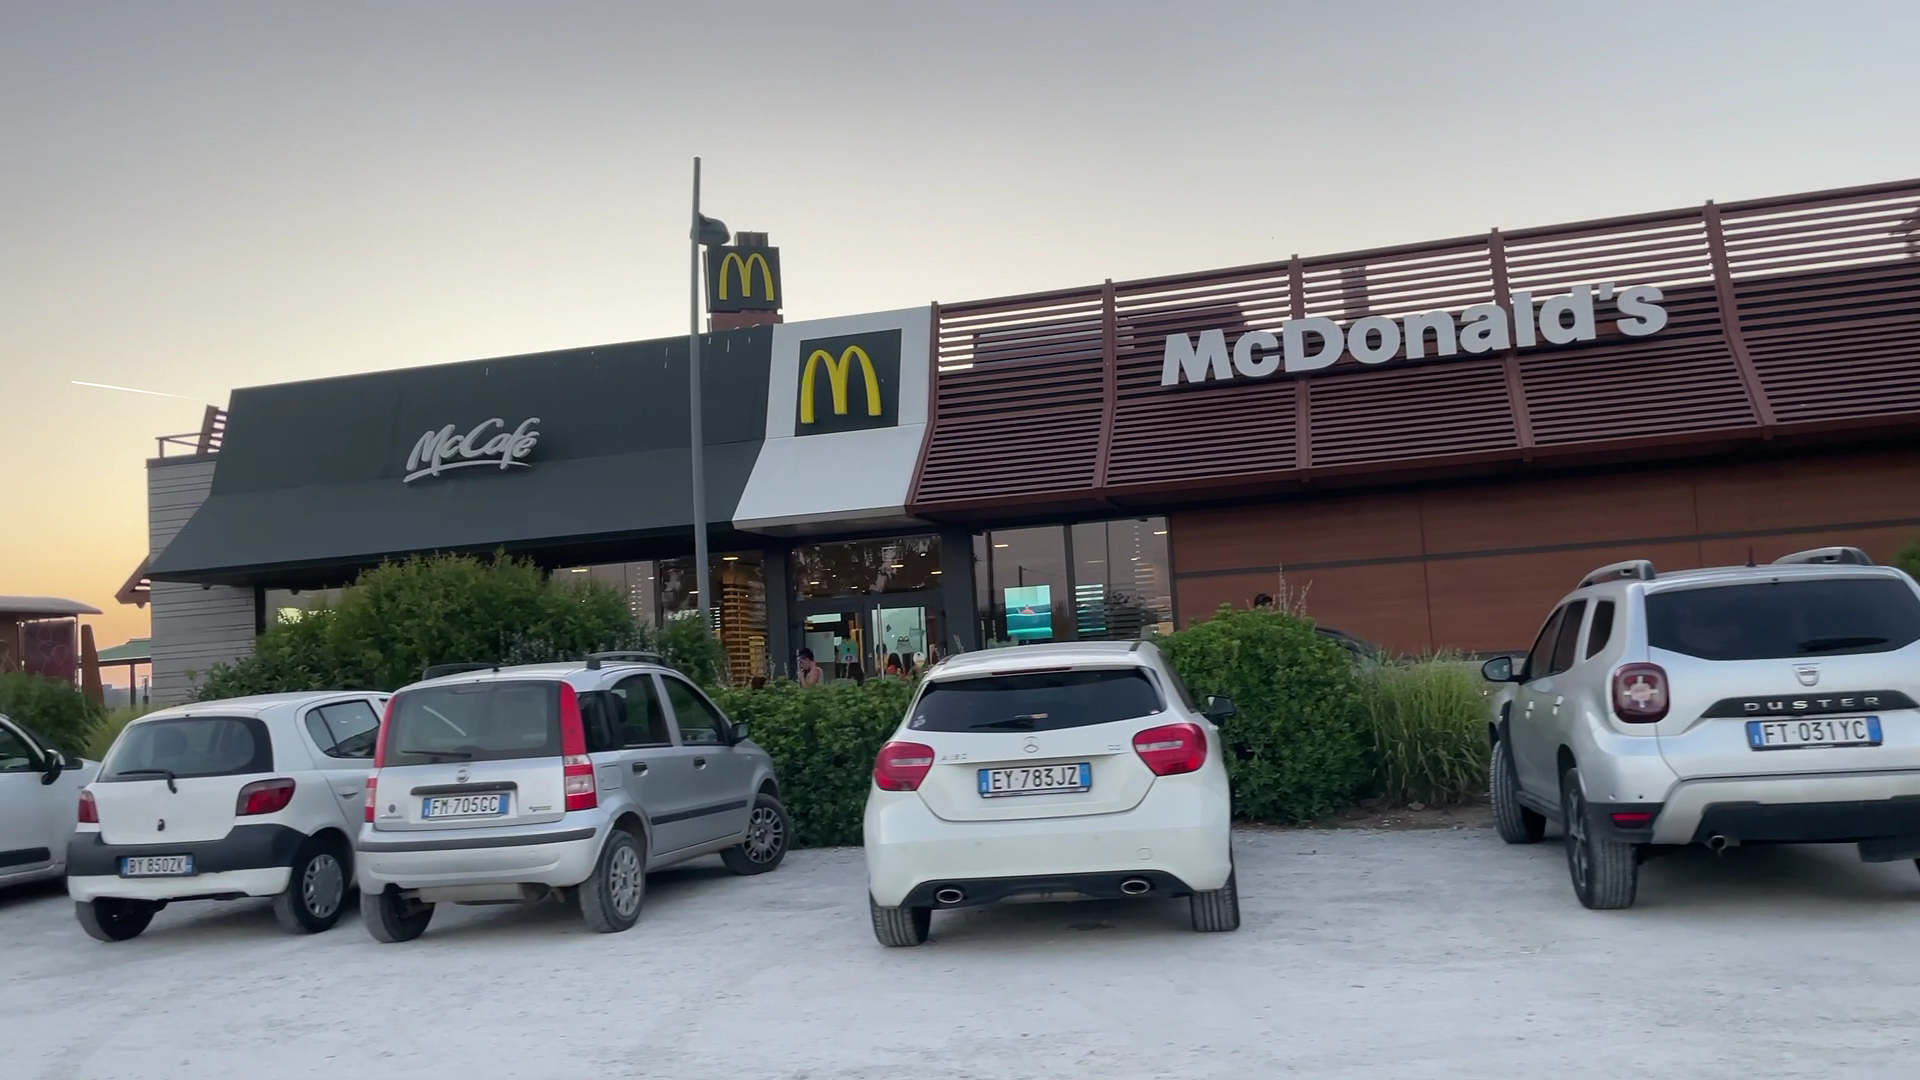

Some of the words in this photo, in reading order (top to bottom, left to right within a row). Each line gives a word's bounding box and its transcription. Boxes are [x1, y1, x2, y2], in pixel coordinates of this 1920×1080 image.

[1161, 281, 1668, 386] McDonald's
[404, 417, 540, 479] McCafé
[1744, 697, 1879, 711] DUSTER
